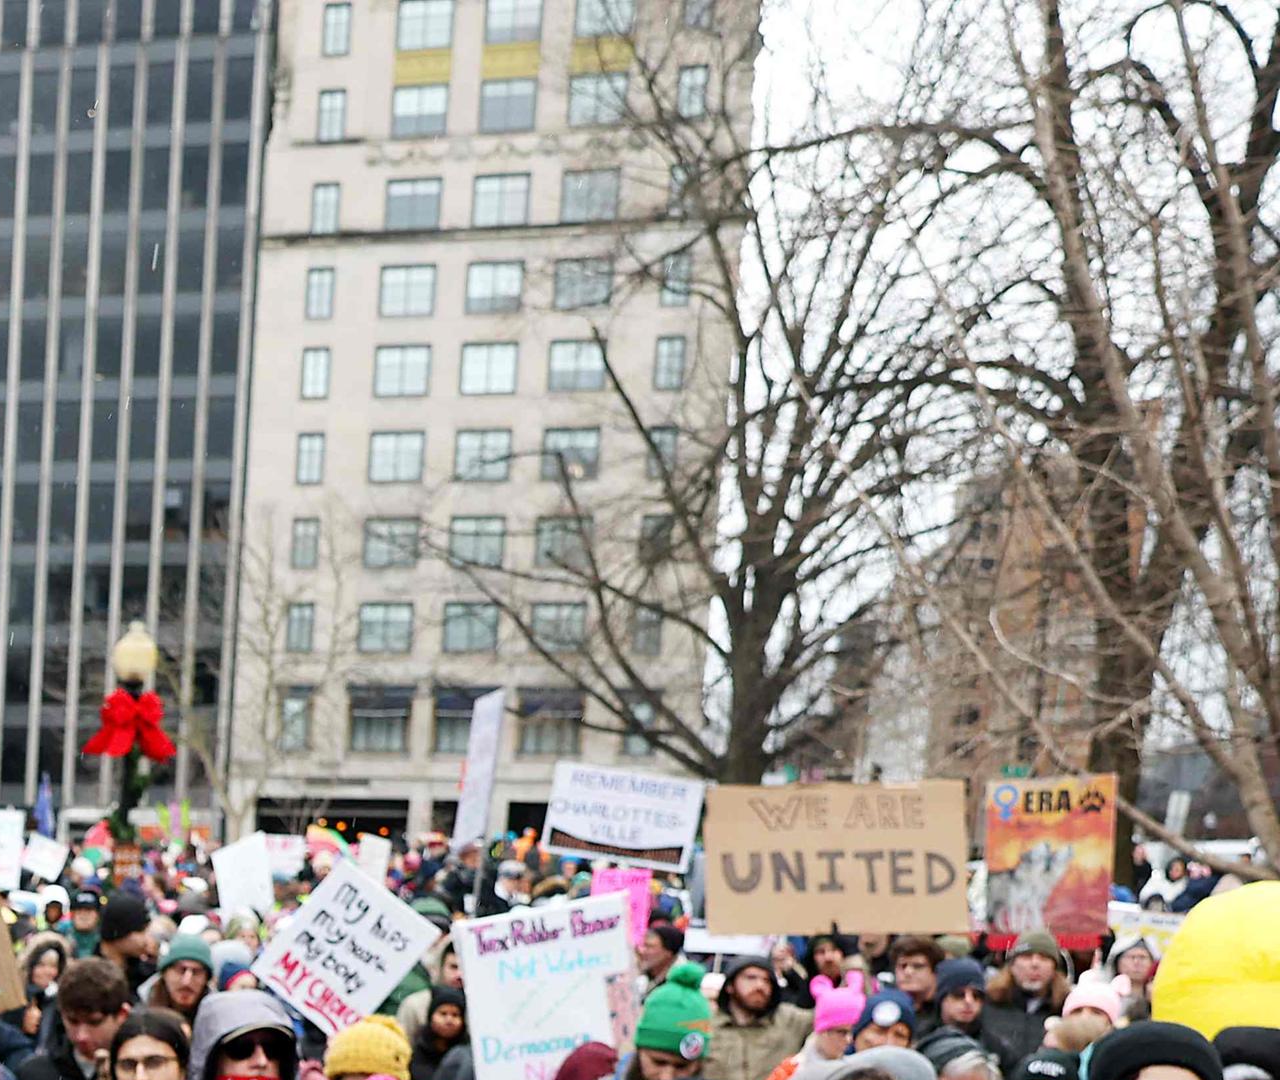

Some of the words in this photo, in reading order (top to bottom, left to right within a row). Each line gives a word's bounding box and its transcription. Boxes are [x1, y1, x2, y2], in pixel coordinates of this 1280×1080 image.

[748, 794, 828, 832] WE
[843, 794, 925, 829] ARE
[1024, 789, 1071, 813] ERA
[722, 850, 956, 894] UNITED
[274, 950, 312, 988] MY
